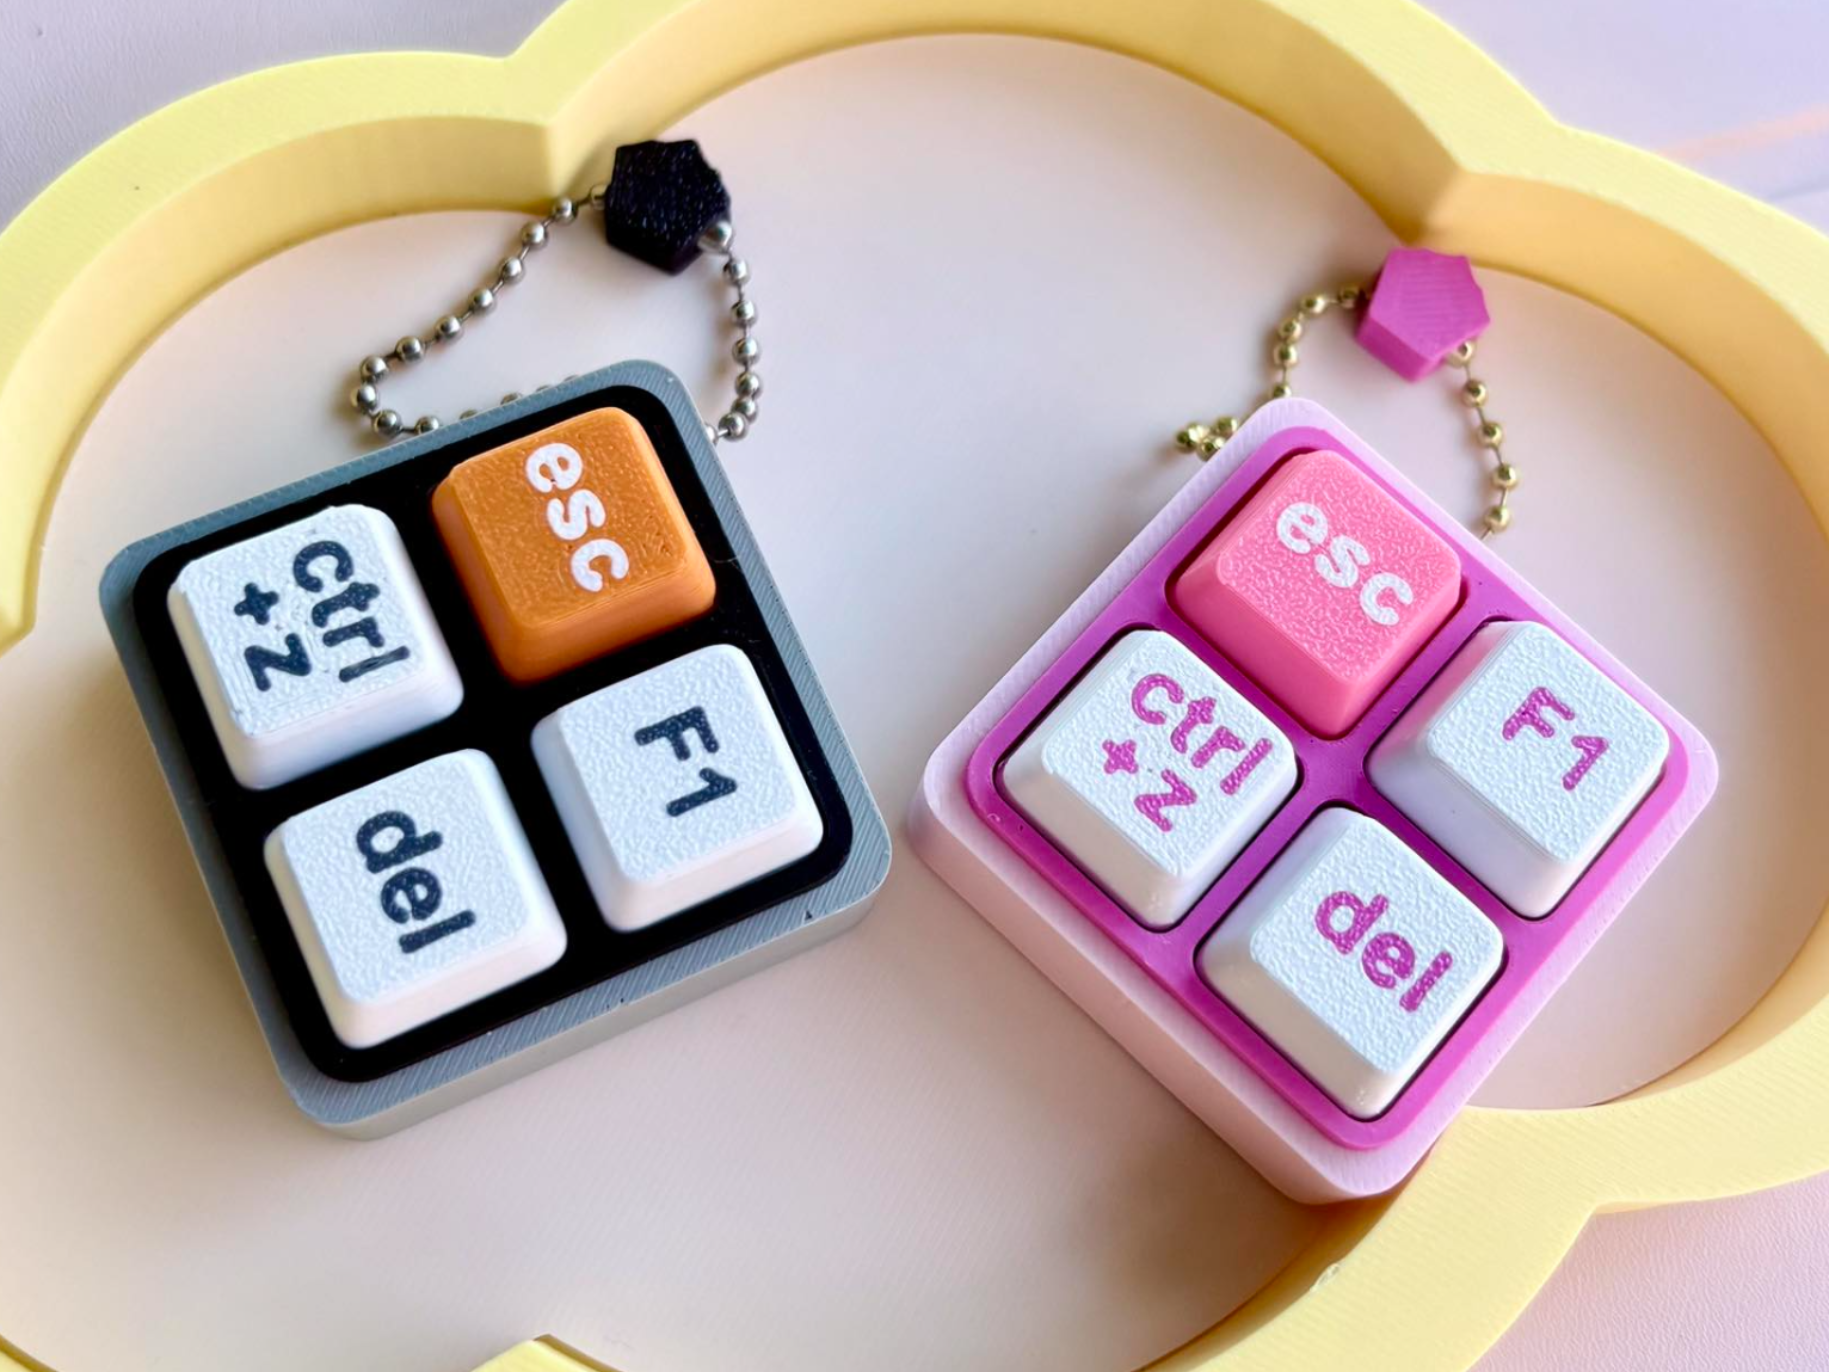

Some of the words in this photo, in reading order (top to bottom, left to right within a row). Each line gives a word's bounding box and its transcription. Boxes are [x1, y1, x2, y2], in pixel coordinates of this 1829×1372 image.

[526, 443, 629, 592] esc
[1277, 502, 1412, 625] esc
[293, 540, 410, 683] ctrl
[634, 707, 737, 817] F1
[1131, 673, 1272, 795] ctrl
[1502, 687, 1609, 791] F1
[356, 810, 476, 953] del
[1315, 890, 1453, 1013] del
